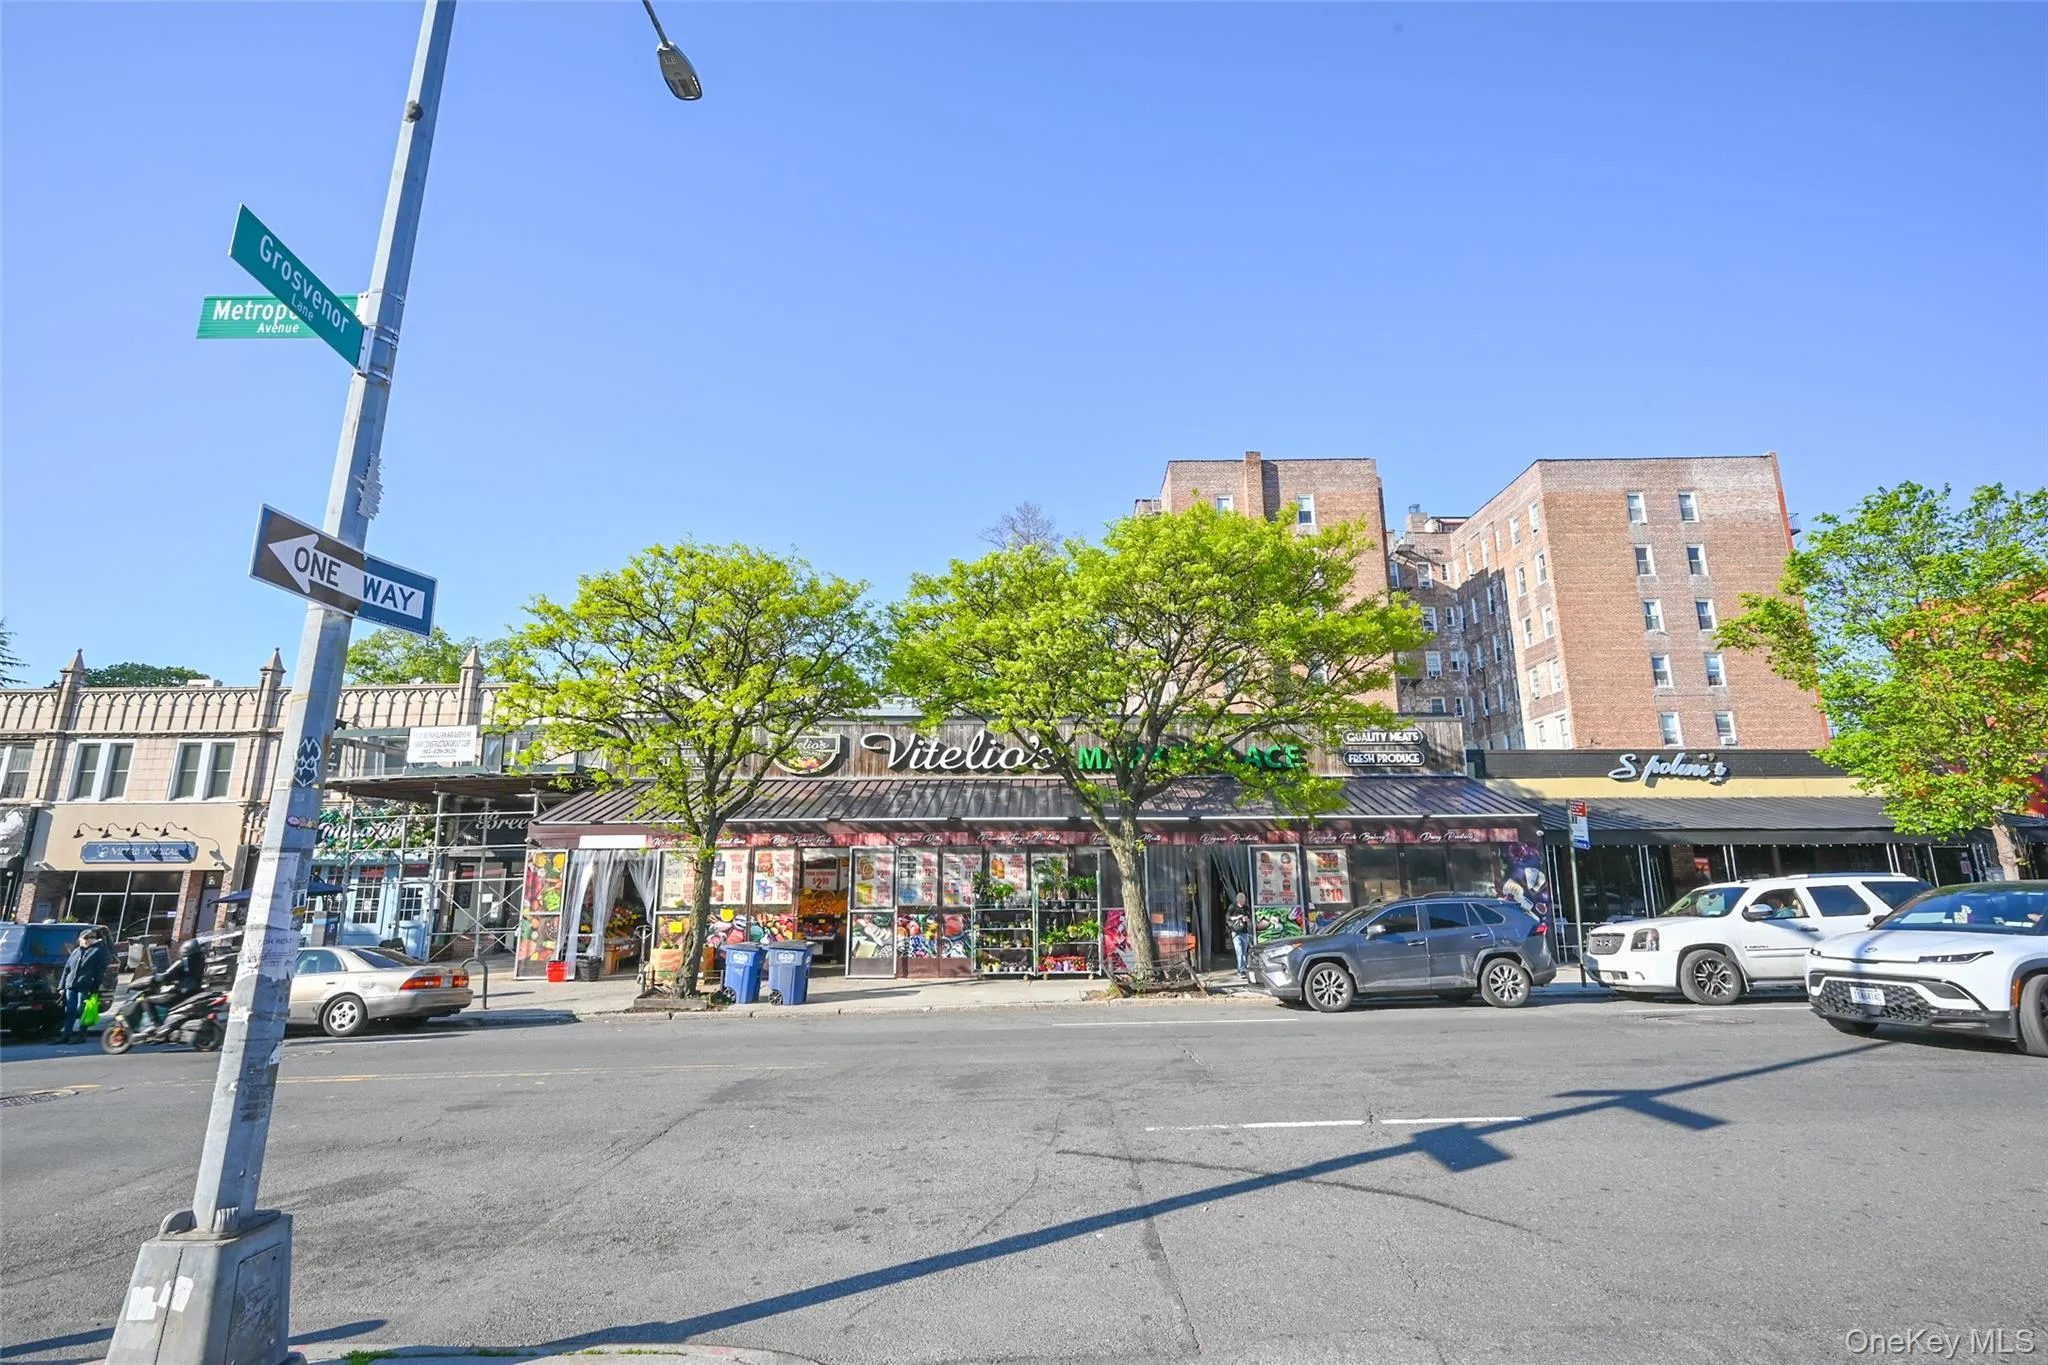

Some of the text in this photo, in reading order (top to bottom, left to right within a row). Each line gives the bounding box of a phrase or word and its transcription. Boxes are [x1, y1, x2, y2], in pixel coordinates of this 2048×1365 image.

[259, 234, 350, 334] Grosvenor
[291, 293, 314, 322] Lane
[255, 322, 300, 334] Avenue
[294, 546, 416, 612] ONE WAY
[860, 730, 1055, 770] Vitelio's
[1346, 731, 1419, 742] QUALITY MEATS
[1348, 753, 1420, 764] FRESH PRODUCE
